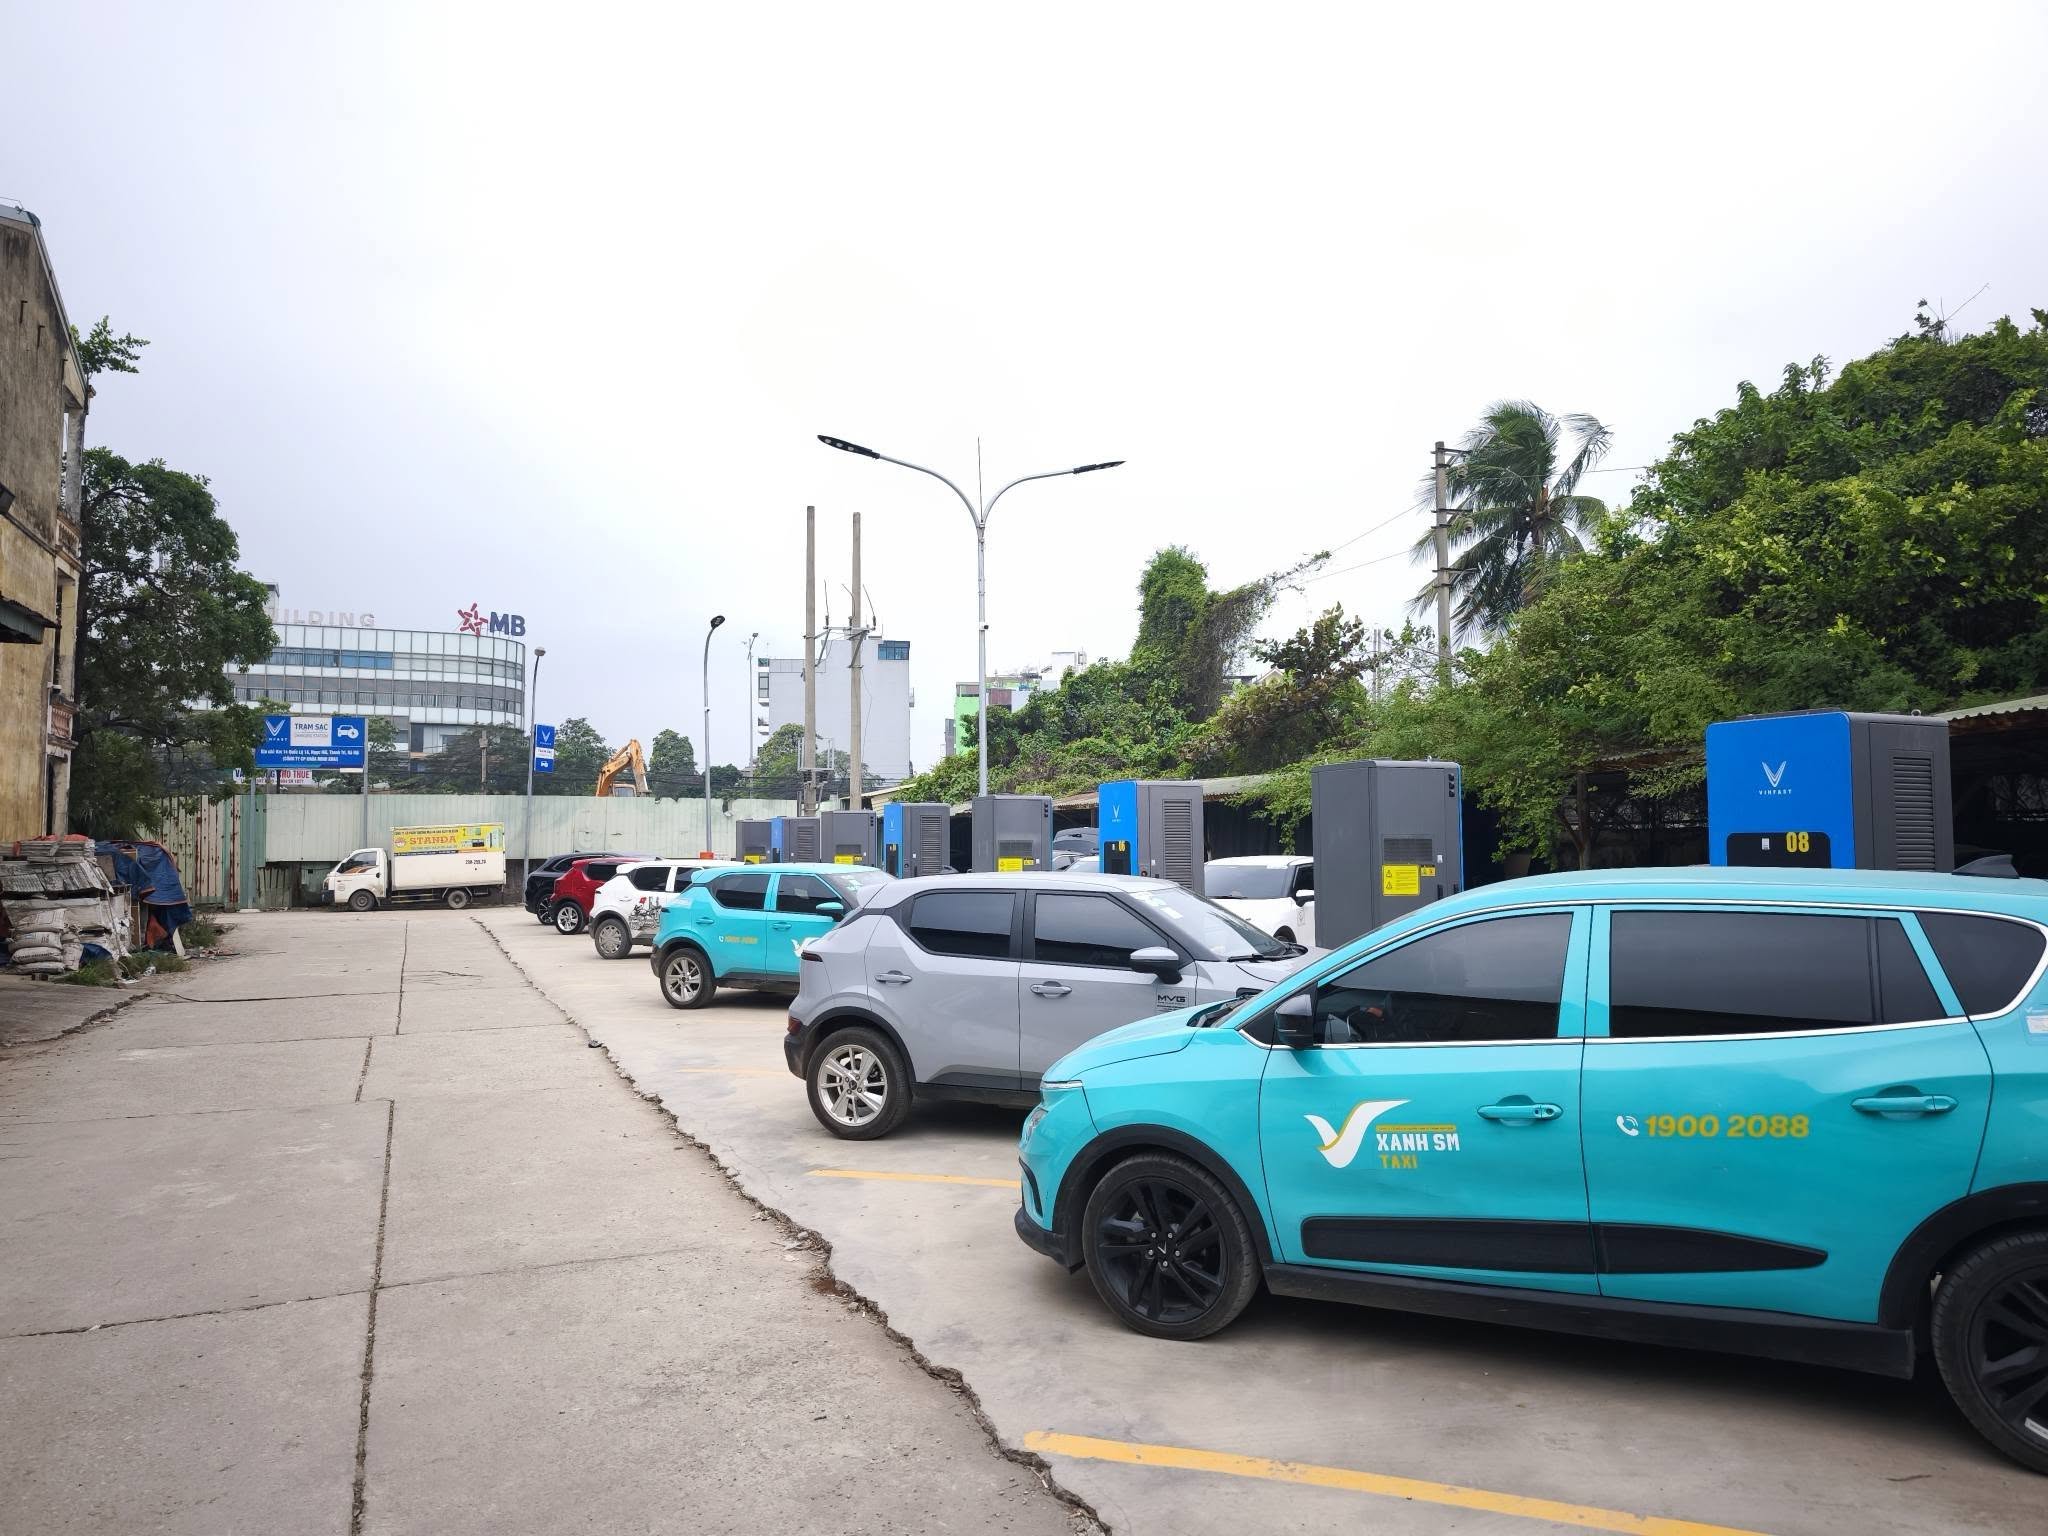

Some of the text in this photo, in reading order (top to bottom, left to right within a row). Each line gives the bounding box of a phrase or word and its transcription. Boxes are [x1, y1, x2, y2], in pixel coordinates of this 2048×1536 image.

[490, 611, 525, 636] MB
[409, 835, 457, 845] STANDA
[1786, 831, 1810, 853] 08
[1645, 1114, 1809, 1138] 1900 2088
[1376, 1133, 1460, 1151] XANH SM
[1378, 1153, 1418, 1169] TAXI
